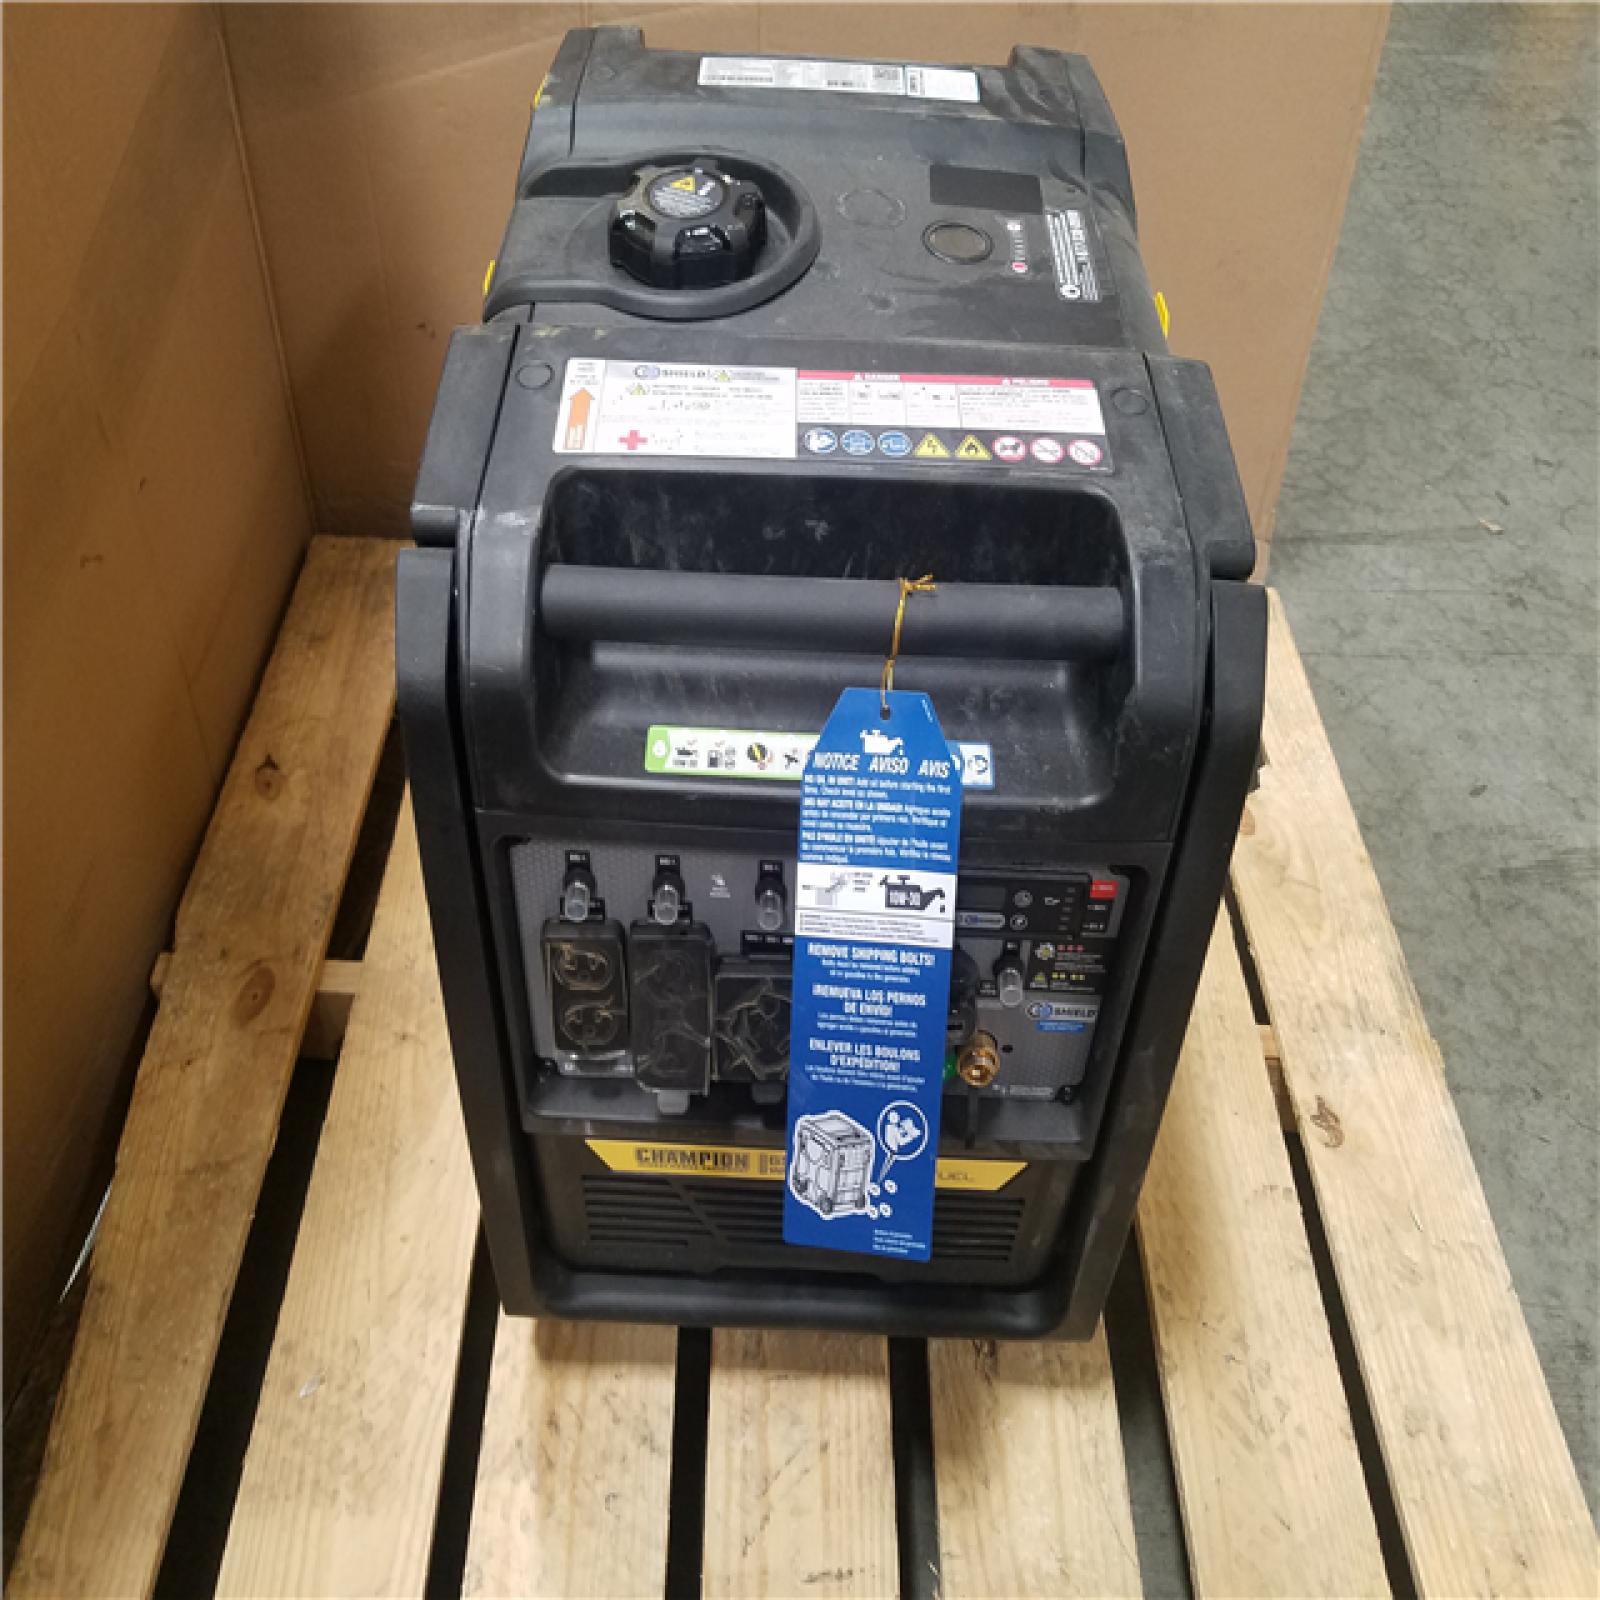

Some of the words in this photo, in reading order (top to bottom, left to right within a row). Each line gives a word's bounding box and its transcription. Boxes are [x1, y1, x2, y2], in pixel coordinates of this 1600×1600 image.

[813, 752, 860, 770] NOTICE
[869, 756, 910, 775] AVISO
[917, 759, 951, 778] AVIS
[808, 942, 848, 958] REMOVE
[852, 947, 898, 963] SHIPPING
[900, 950, 935, 966] BOLTS!
[1055, 1007, 1097, 1018] SHIELD
[810, 1038, 852, 1053] ENLEVER
[854, 1043, 872, 1056] LES
[874, 1045, 921, 1062] BOULONS
[635, 1147, 748, 1168] CHAMPION
